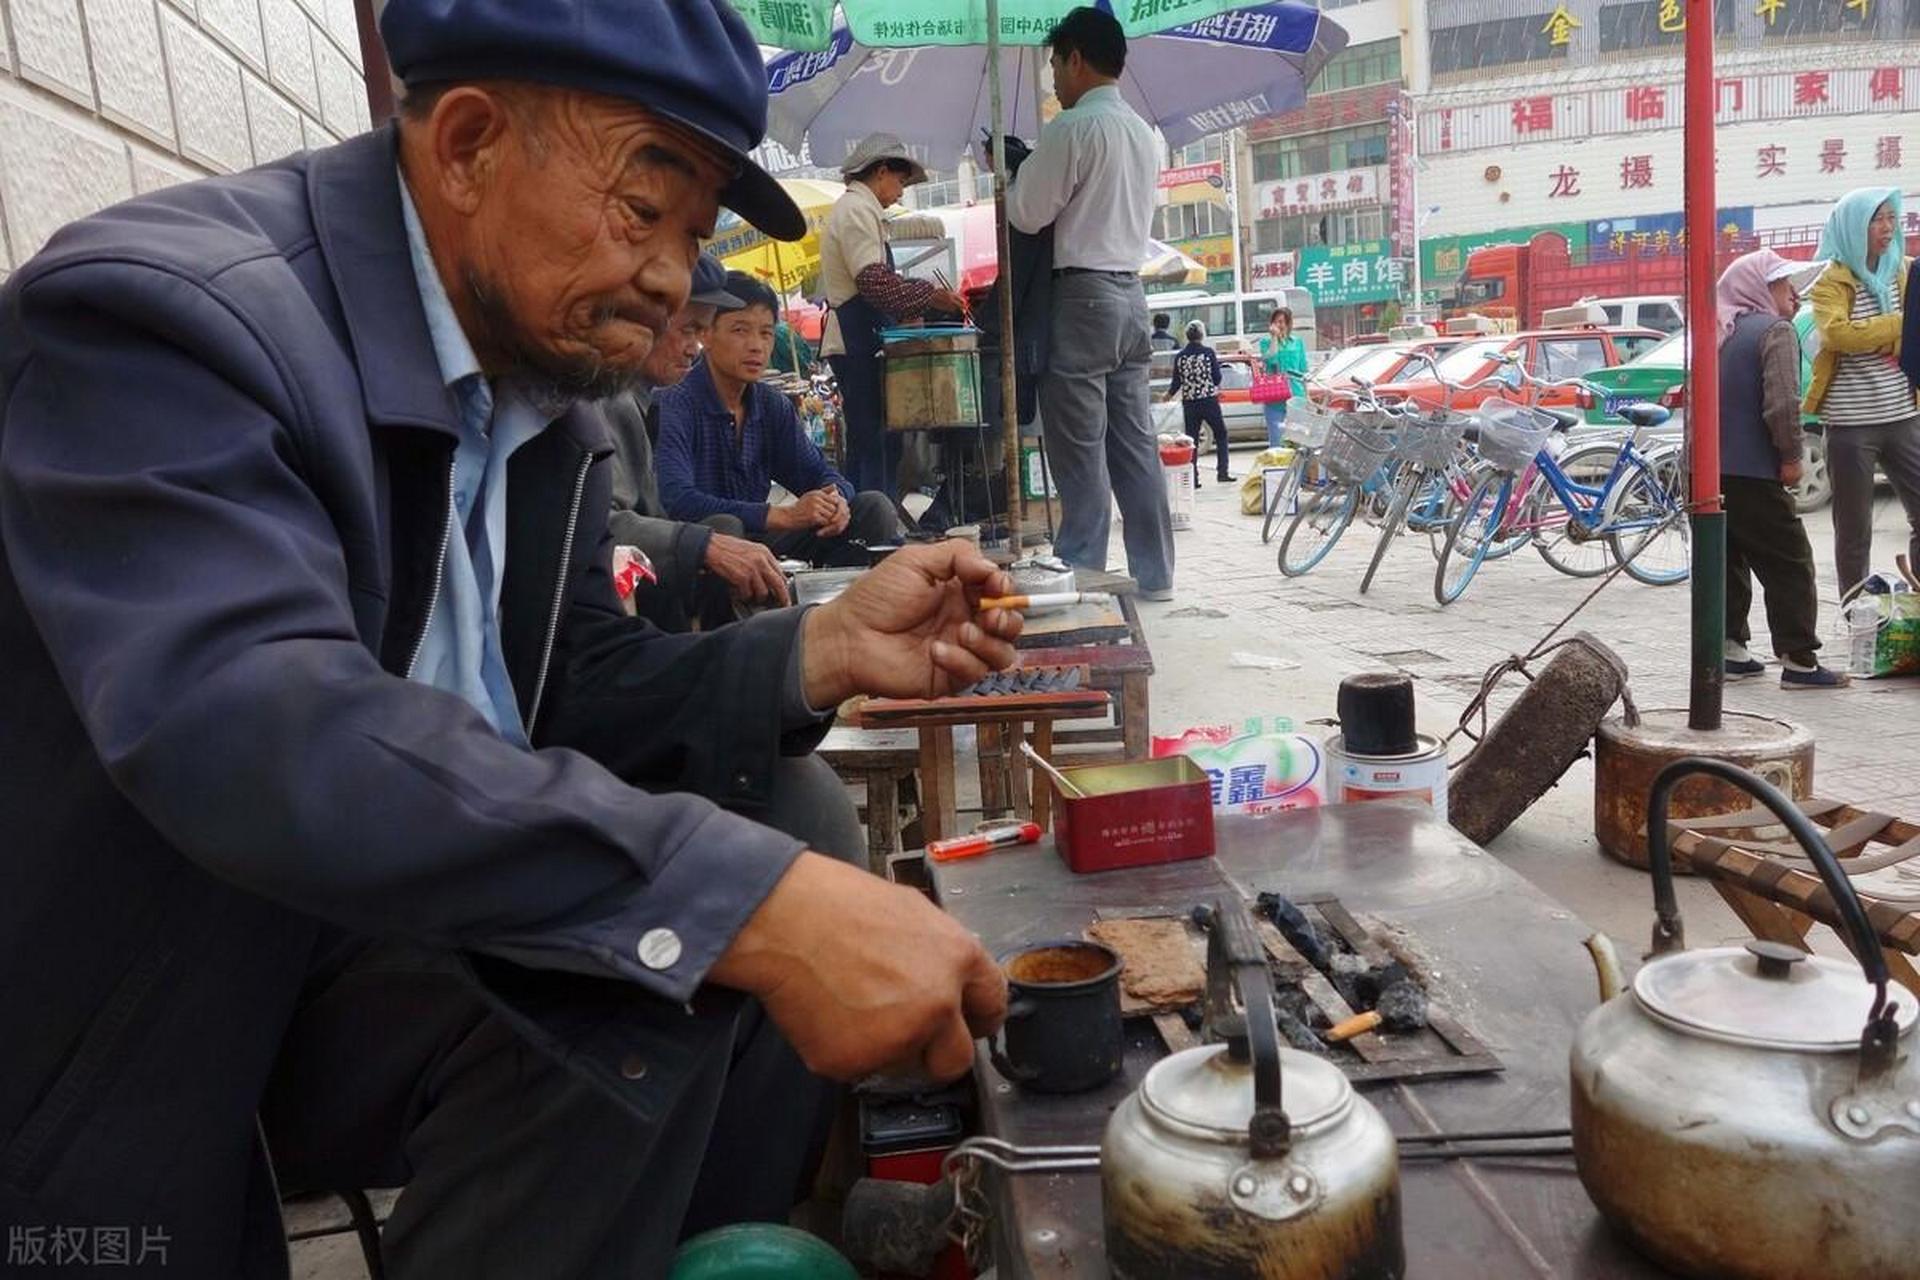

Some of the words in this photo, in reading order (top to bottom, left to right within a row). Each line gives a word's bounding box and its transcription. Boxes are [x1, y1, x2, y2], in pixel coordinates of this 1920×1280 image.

[1549, 135, 1904, 198] 龙摄实景摄
[1306, 256, 1404, 289] 羊肉馆
